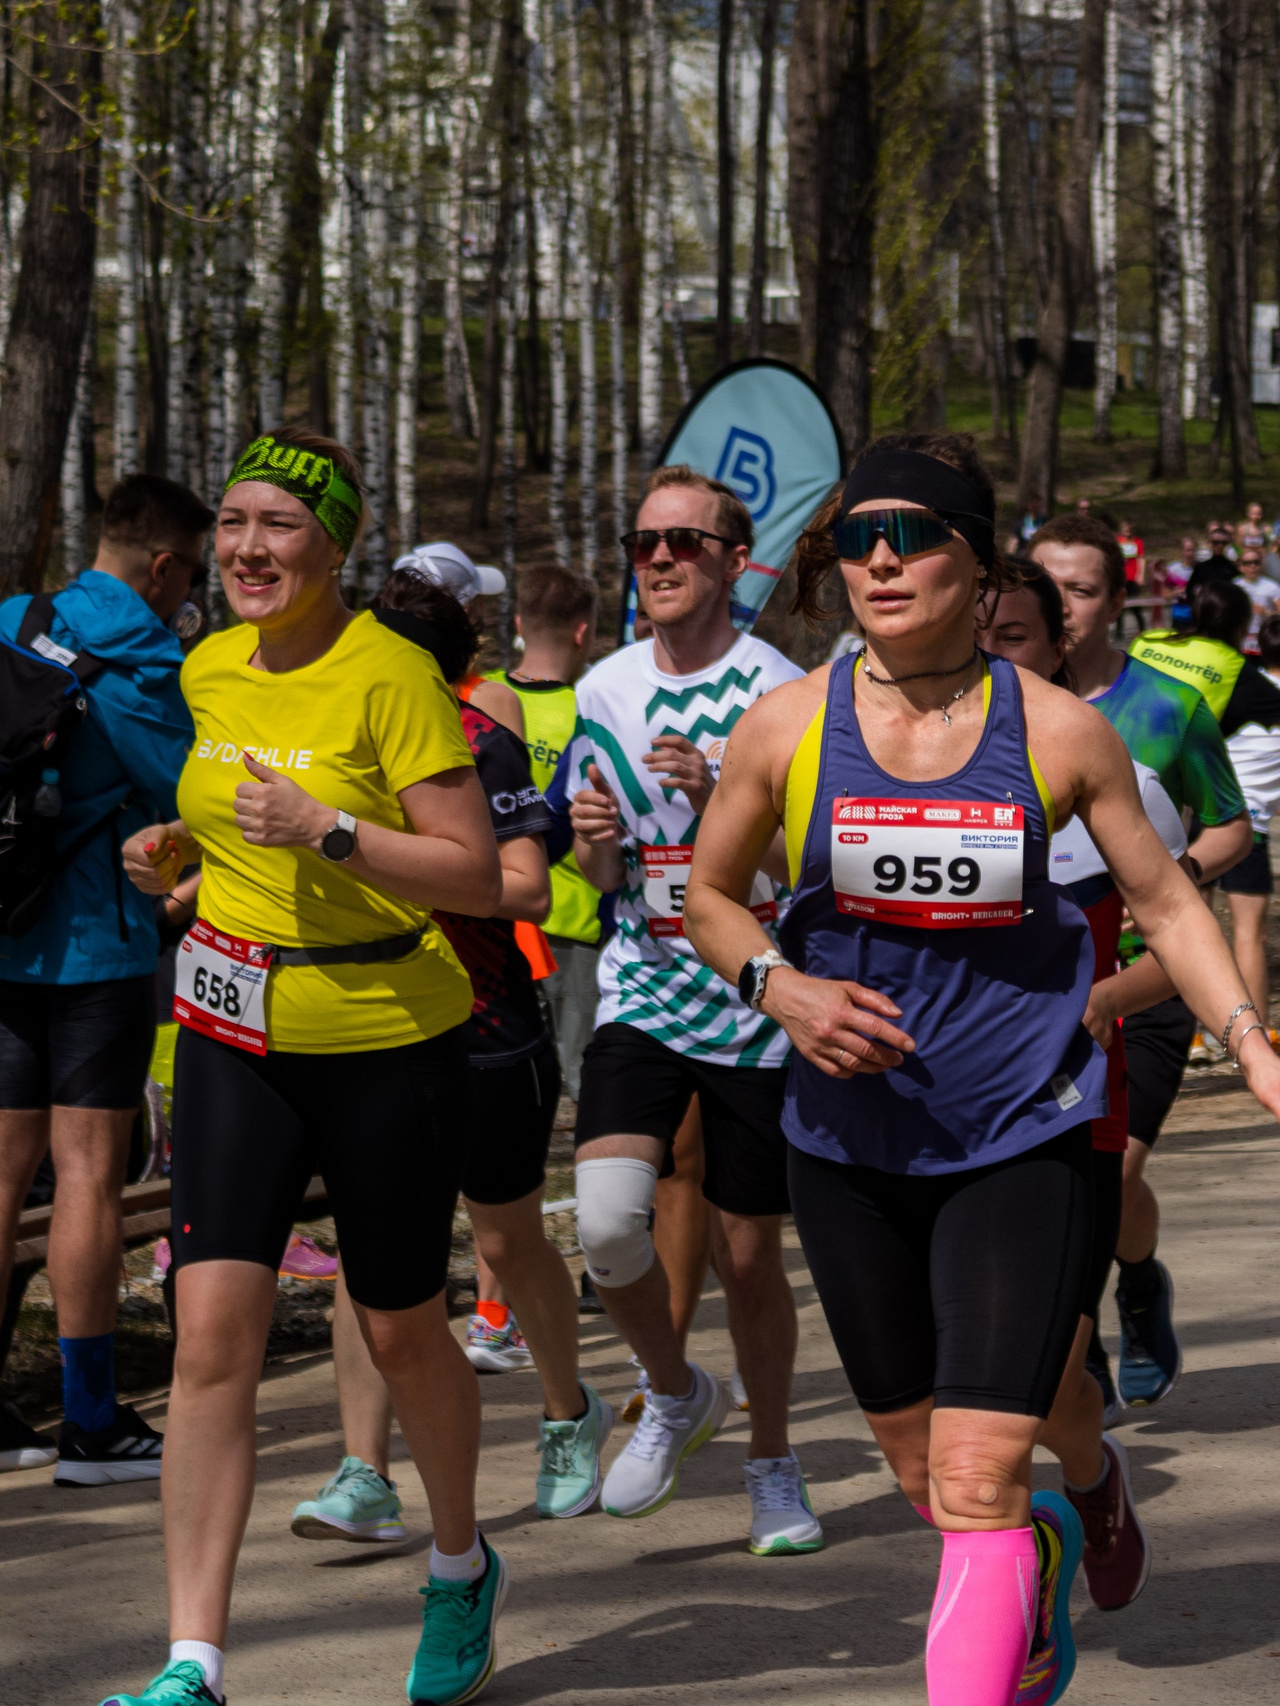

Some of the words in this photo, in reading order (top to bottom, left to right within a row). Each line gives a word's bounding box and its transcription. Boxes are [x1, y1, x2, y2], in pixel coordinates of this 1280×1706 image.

[1141, 648, 1223, 684] Волонтёр
[879, 806, 917, 814] МАЙСКАЯ
[961, 834, 1018, 843] ВИКТОРИЯ
[873, 854, 982, 896] 959
[194, 966, 242, 1018] 658
